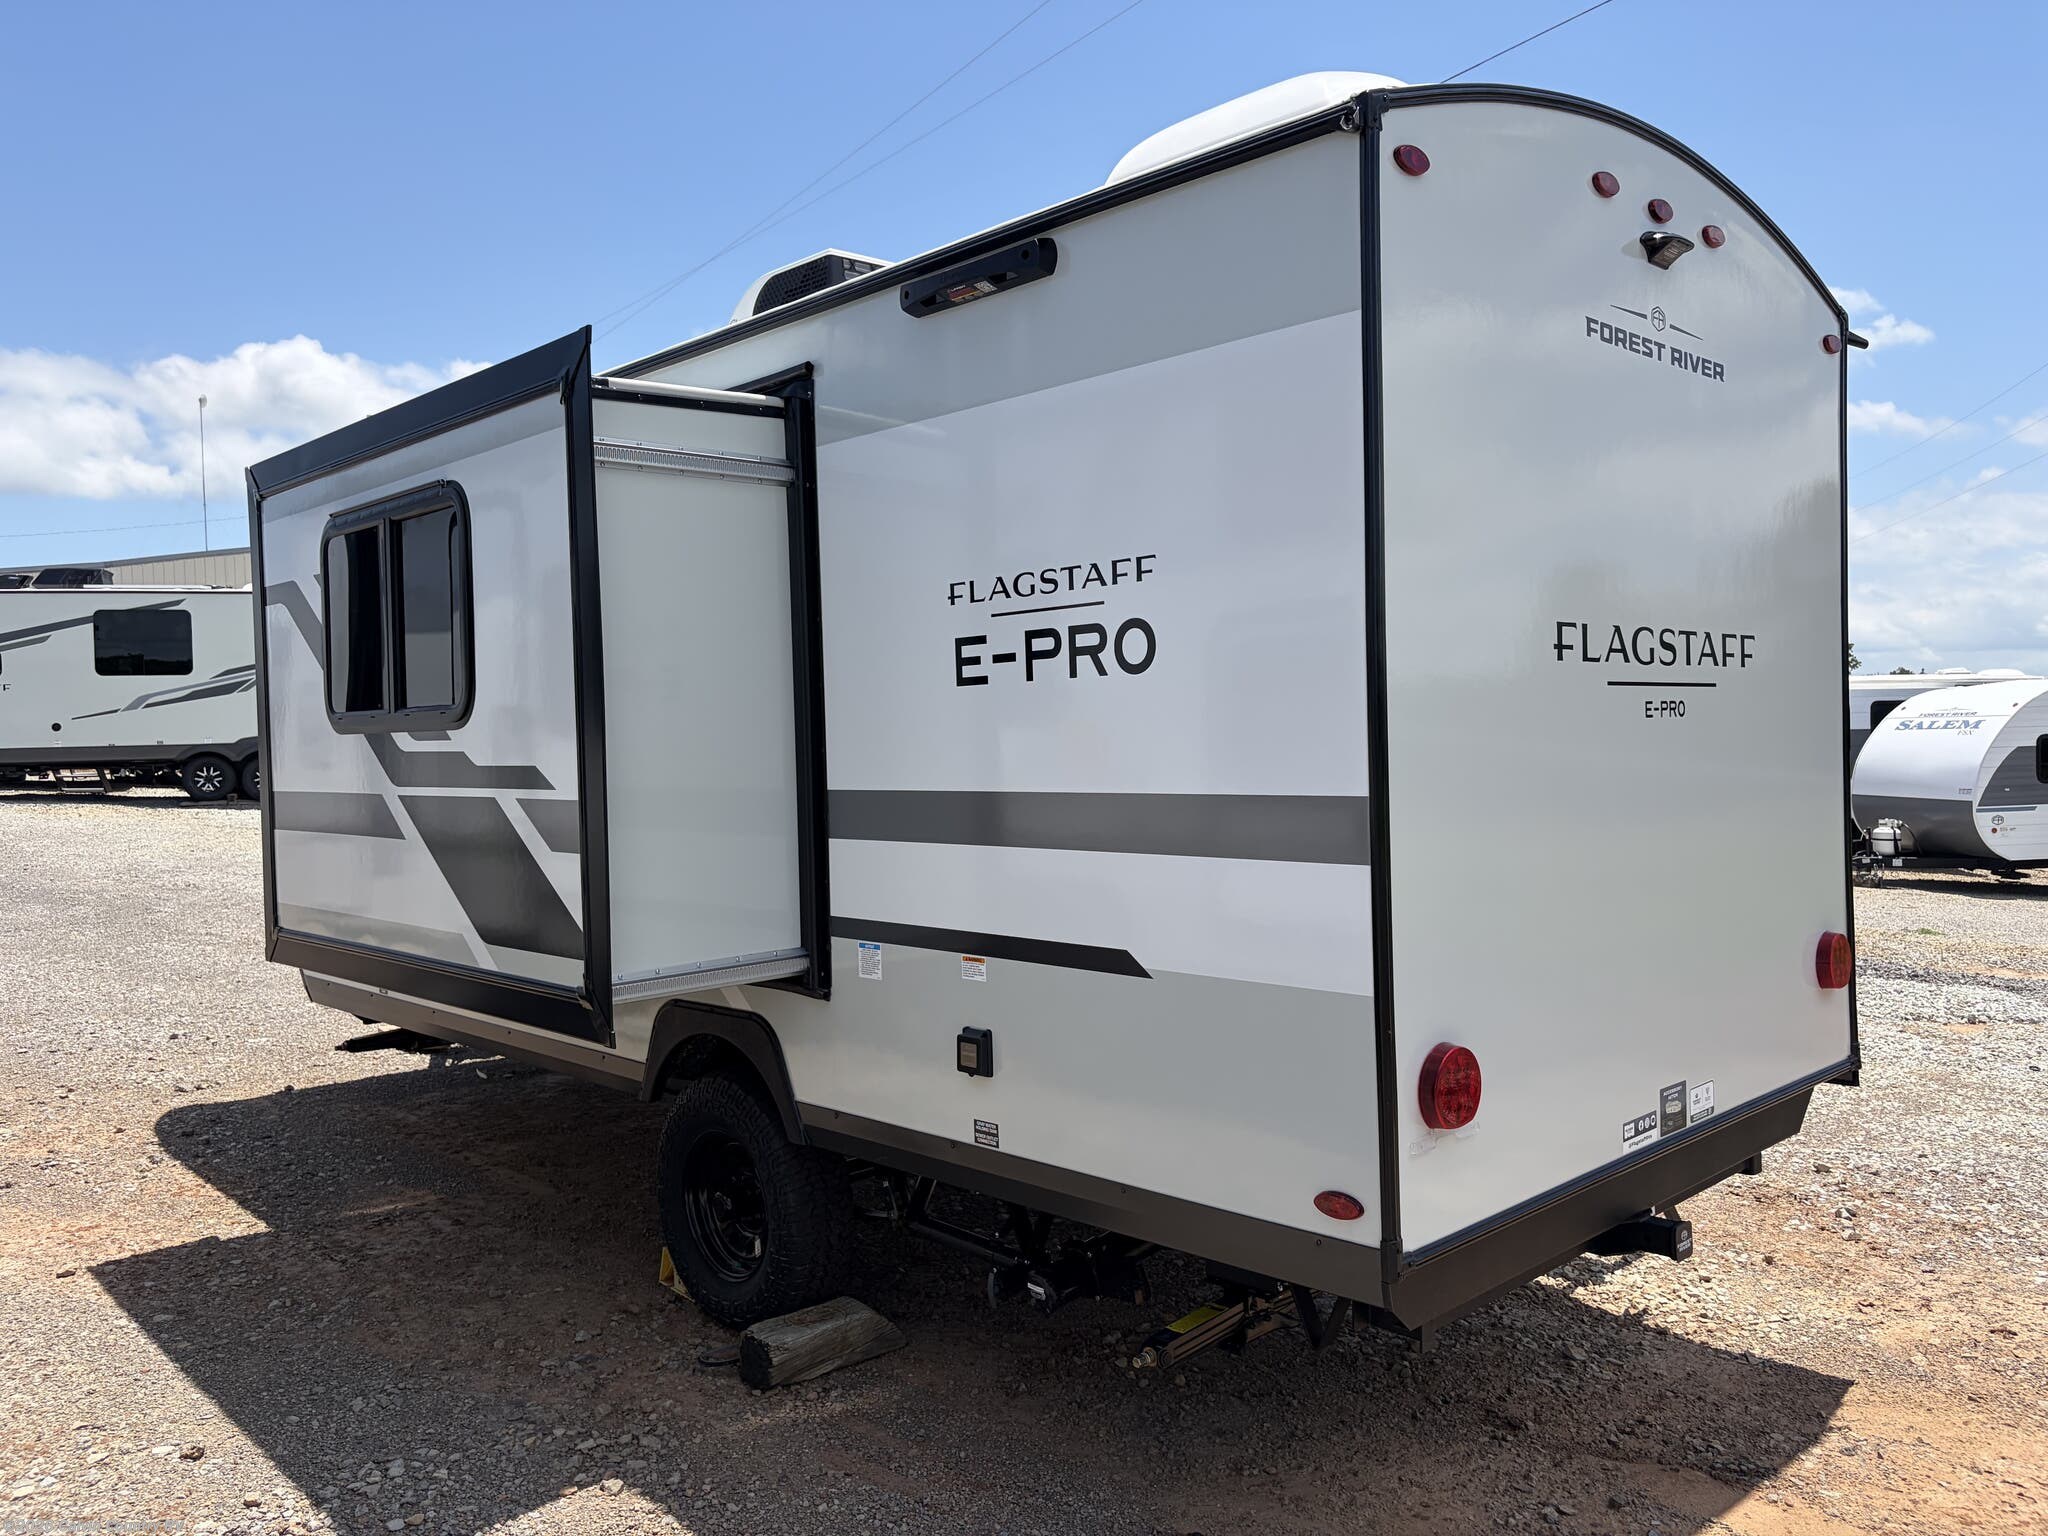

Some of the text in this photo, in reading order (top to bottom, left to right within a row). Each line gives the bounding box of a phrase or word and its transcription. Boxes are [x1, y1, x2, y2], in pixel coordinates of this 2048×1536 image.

[1584, 315, 1725, 383] FOREST RIVER
[947, 553, 1157, 606] FLAGSTAFF
[954, 617, 1157, 687] E-PRO
[1553, 621, 1756, 668] FLAGSTAFF
[1644, 700, 1686, 718] E-PRO
[1894, 719, 1986, 731] SALEM
